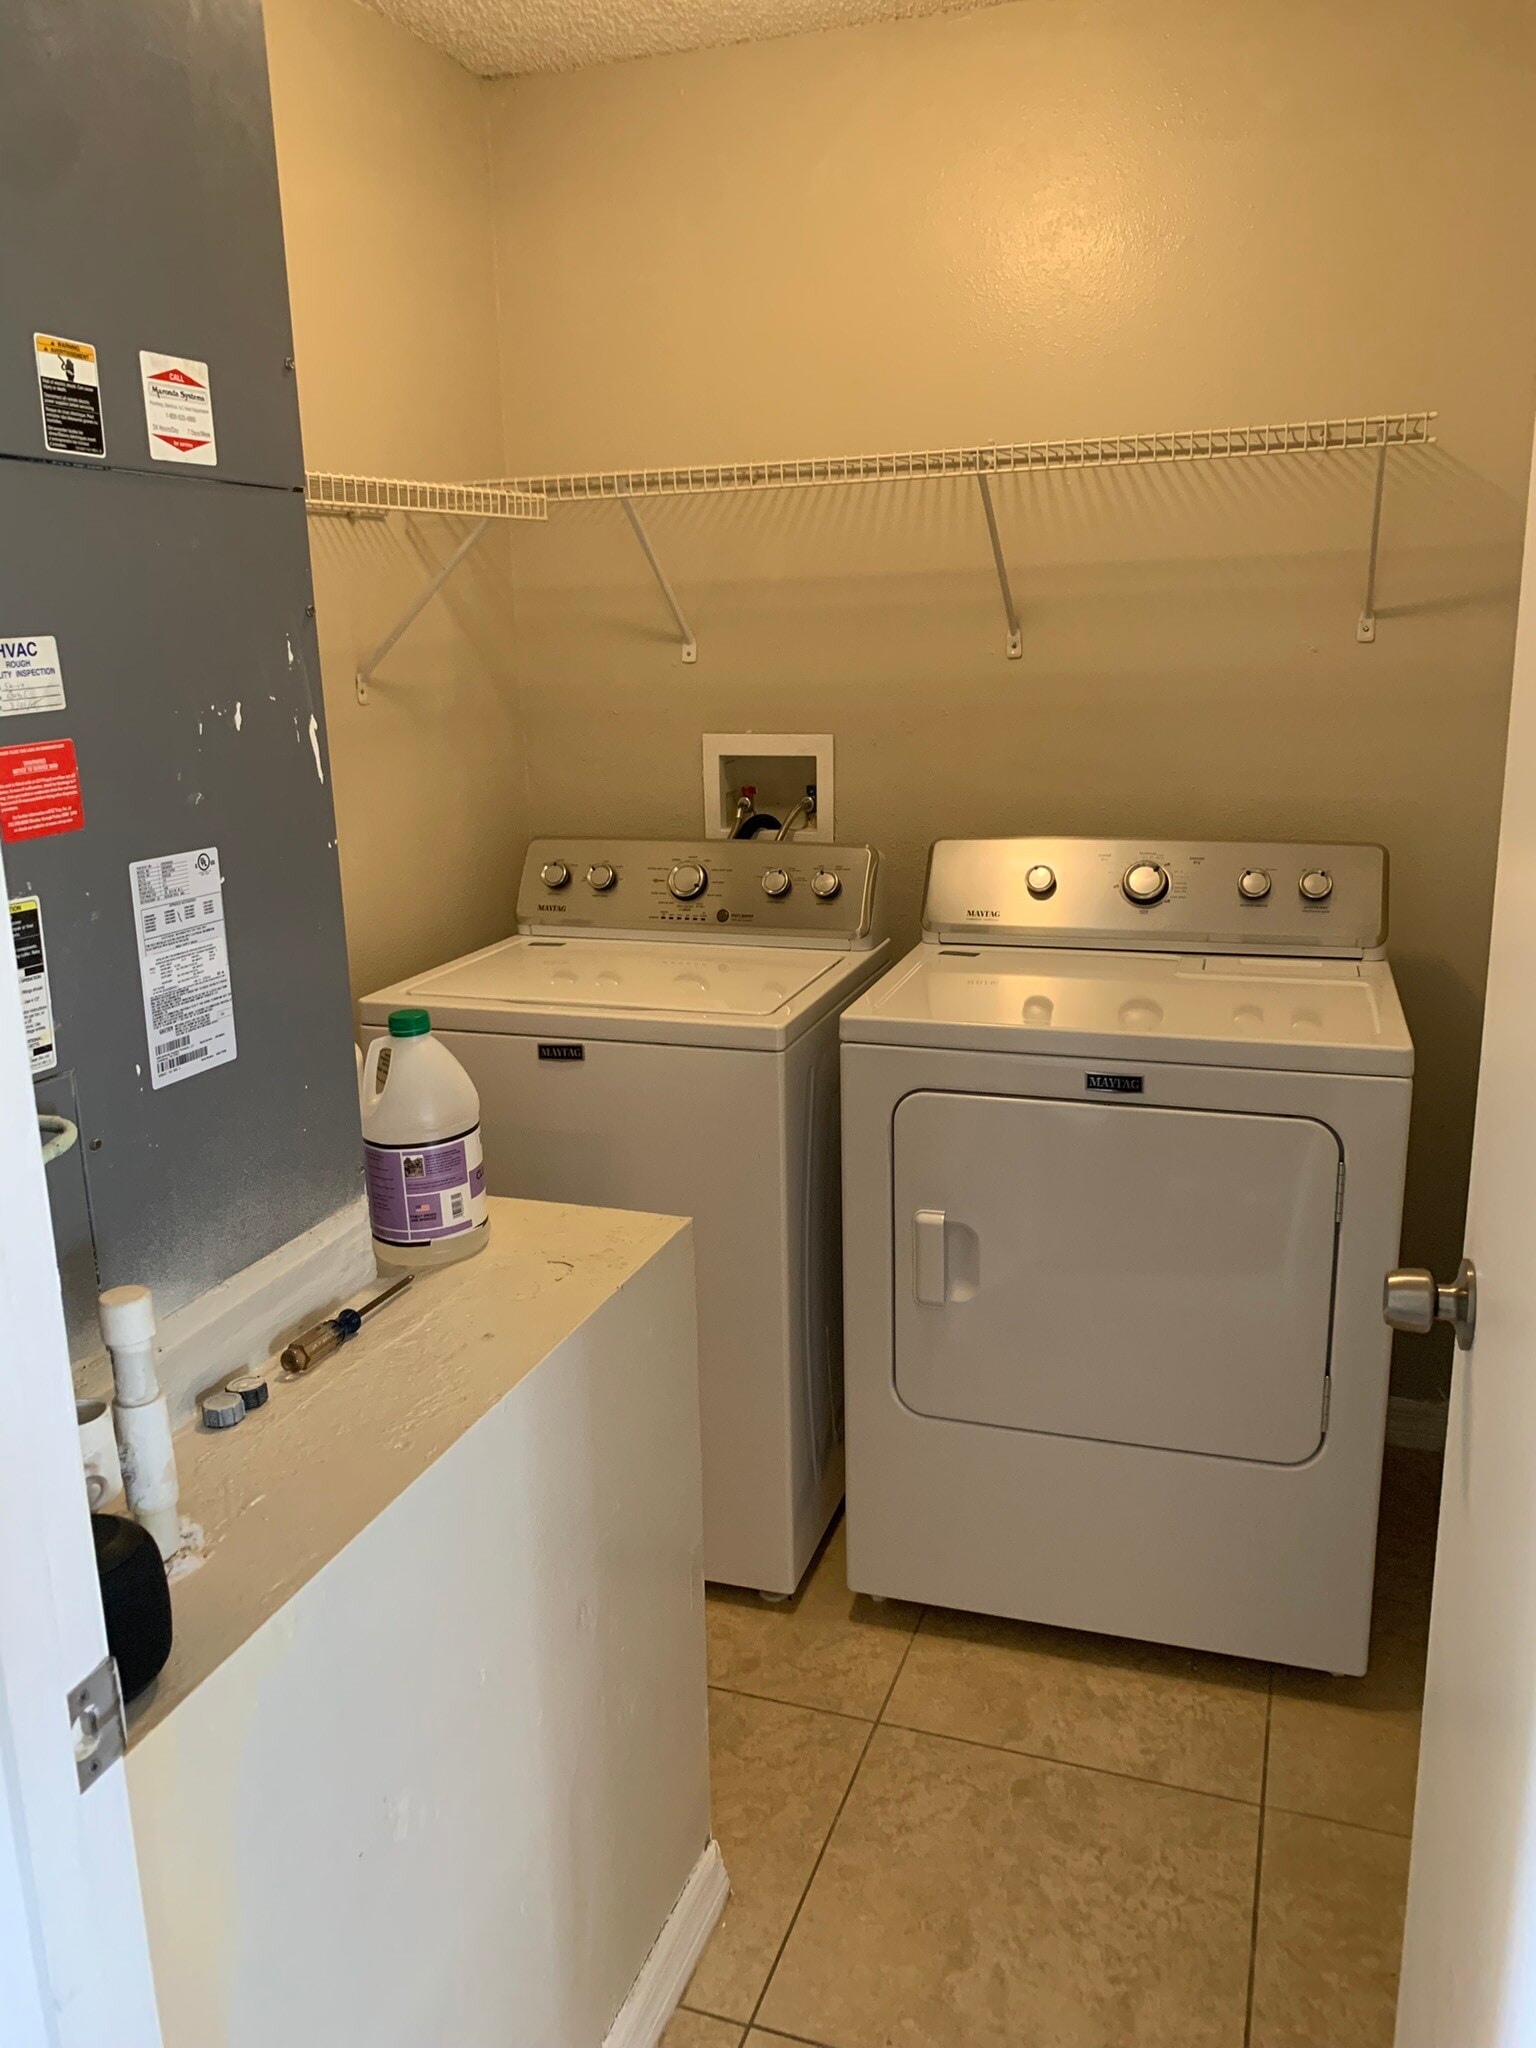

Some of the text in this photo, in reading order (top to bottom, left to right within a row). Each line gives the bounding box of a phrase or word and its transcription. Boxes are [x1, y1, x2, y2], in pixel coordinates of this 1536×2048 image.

[168, 373, 185, 383] CALL
[180, 391, 206, 401] Systems
[0, 642, 38, 658] HVAC
[5, 660, 31, 668] ROUGH
[16, 668, 56, 677] INSPECTION
[537, 904, 567, 912] MAYTAG
[966, 910, 1000, 918] MAYTAG
[541, 1047, 581, 1057] MAYTAG
[1089, 1076, 1140, 1089] MAYTAG
